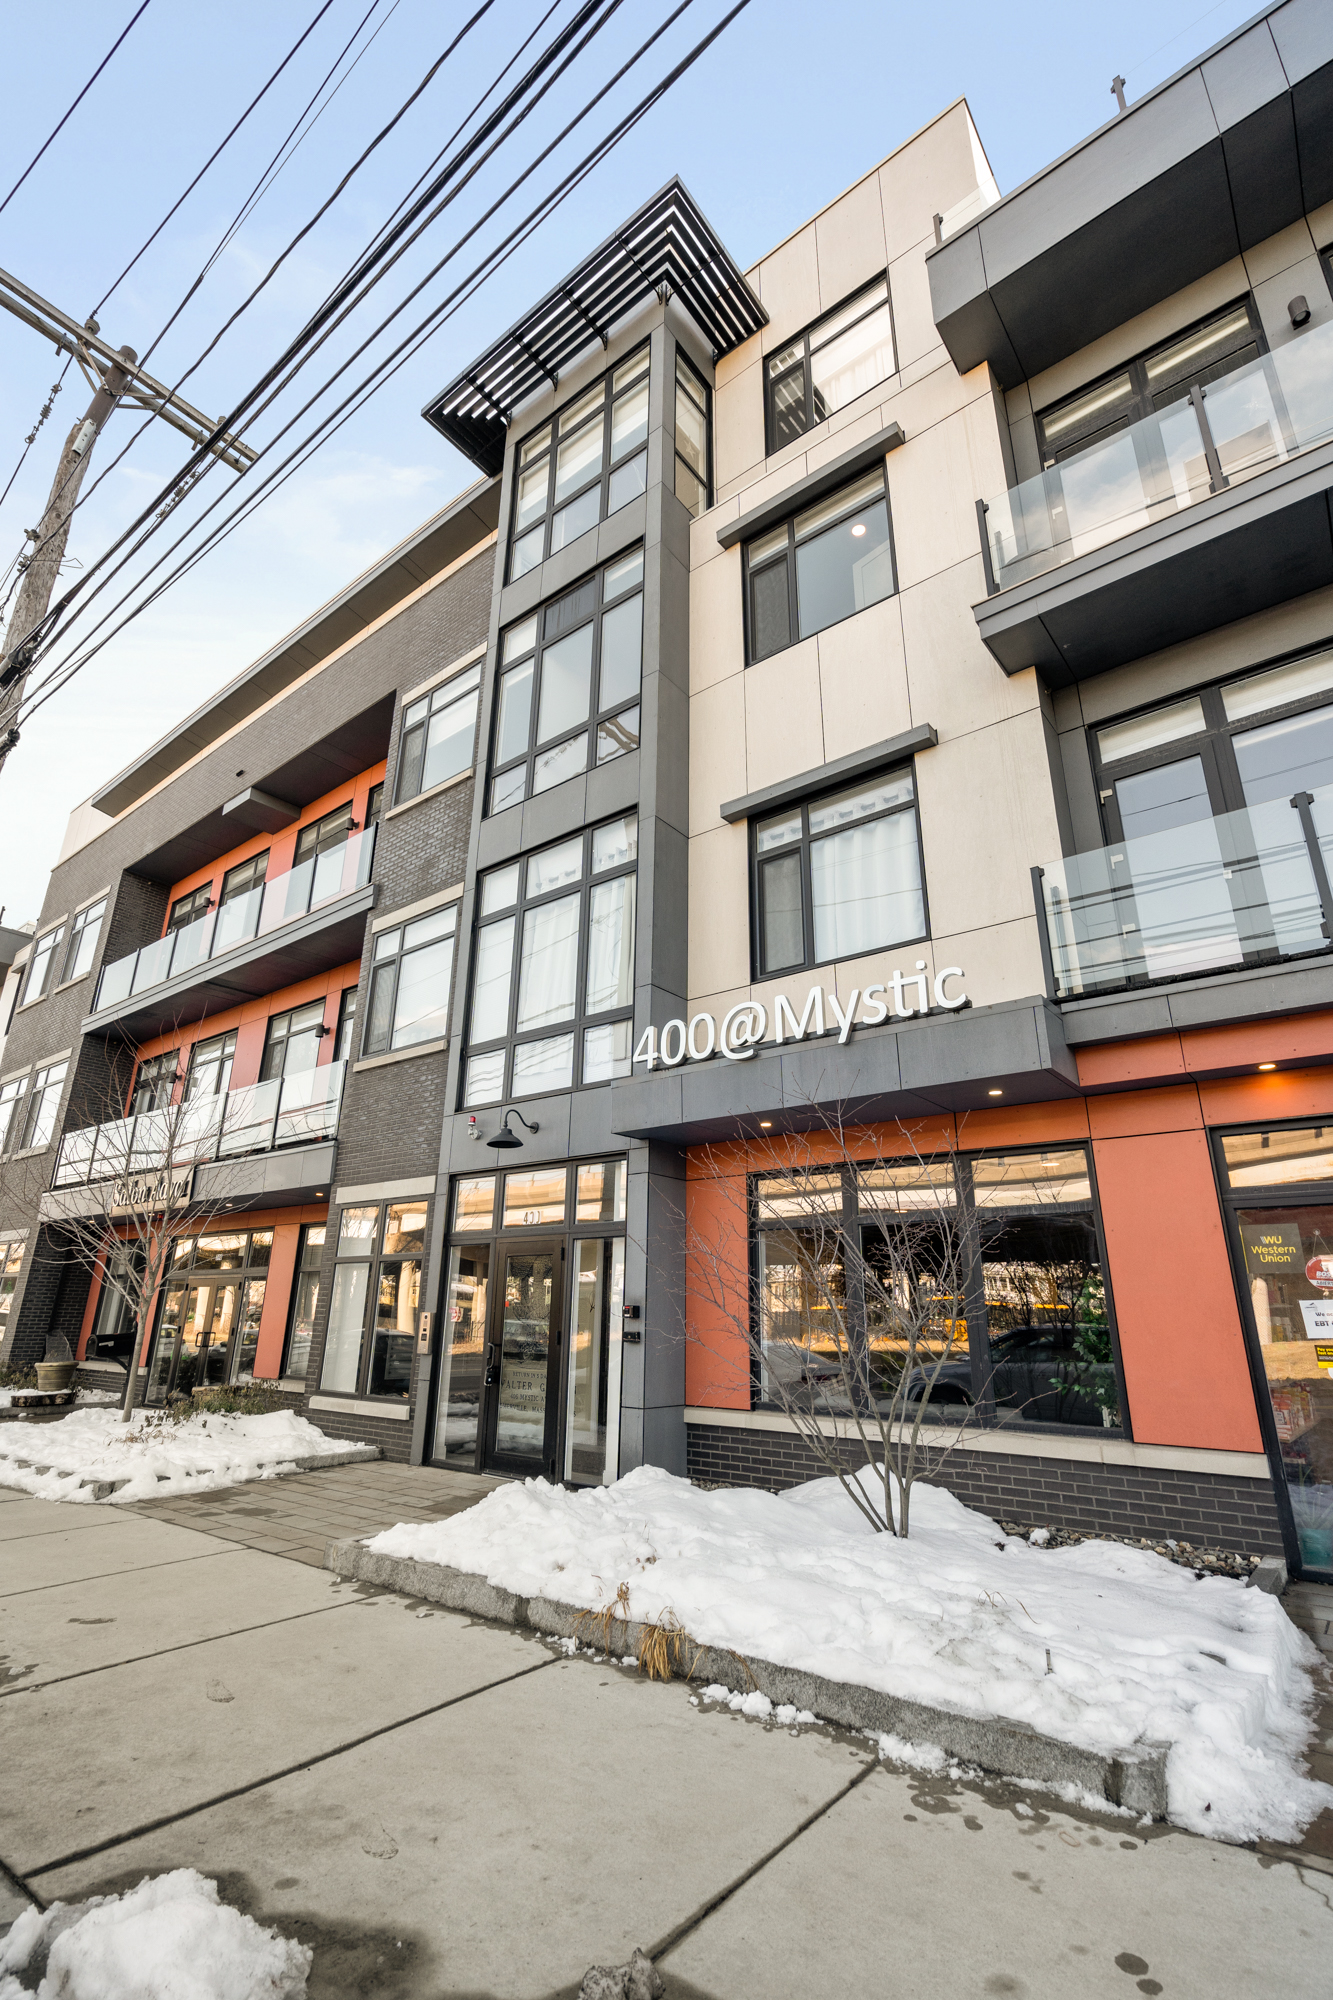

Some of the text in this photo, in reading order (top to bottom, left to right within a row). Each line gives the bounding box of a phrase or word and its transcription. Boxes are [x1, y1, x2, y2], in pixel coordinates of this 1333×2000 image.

[632, 960, 970, 1069] 400@Mystic
[113, 1179, 151, 1207] Salon
[1260, 1235, 1282, 1244] WU
[1250, 1245, 1296, 1254] Western
[1260, 1253, 1291, 1263] Union
[519, 1394, 539, 1402] MYSTIC
